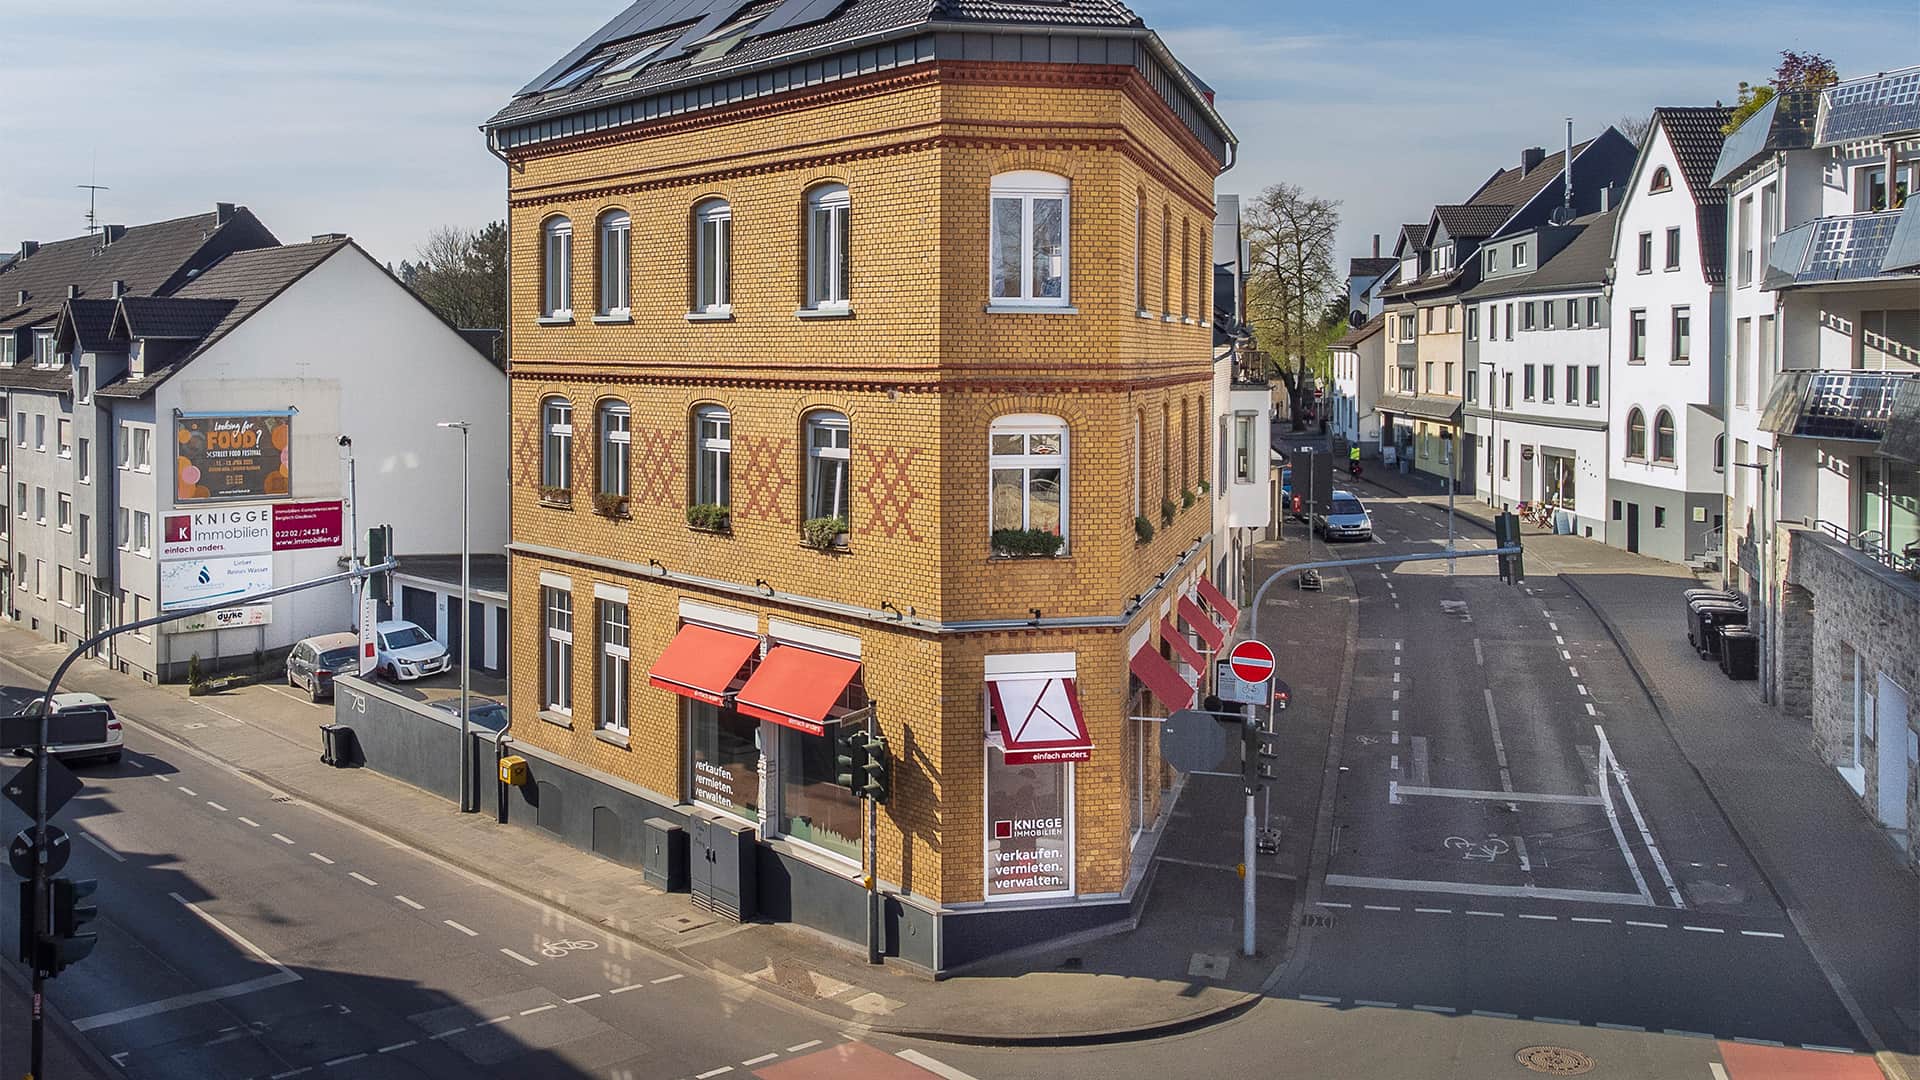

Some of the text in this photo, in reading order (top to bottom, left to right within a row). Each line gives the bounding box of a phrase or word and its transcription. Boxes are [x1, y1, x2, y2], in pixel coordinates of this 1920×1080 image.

[214, 420, 254, 437] Looking for
[194, 510, 269, 526] KNIGGE
[179, 527, 189, 540] K
[194, 526, 269, 542] Immobilien
[164, 546, 195, 555] einfach
[343, 689, 366, 714] 79
[1032, 751, 1088, 761] einfach anders.
[1013, 818, 1063, 830] KNIGGE
[1013, 829, 1063, 837] IMMOBILIEN
[995, 848, 1063, 862] verkaufen.
[995, 863, 1063, 875] vermieten.
[995, 876, 1063, 888] verwalten.
